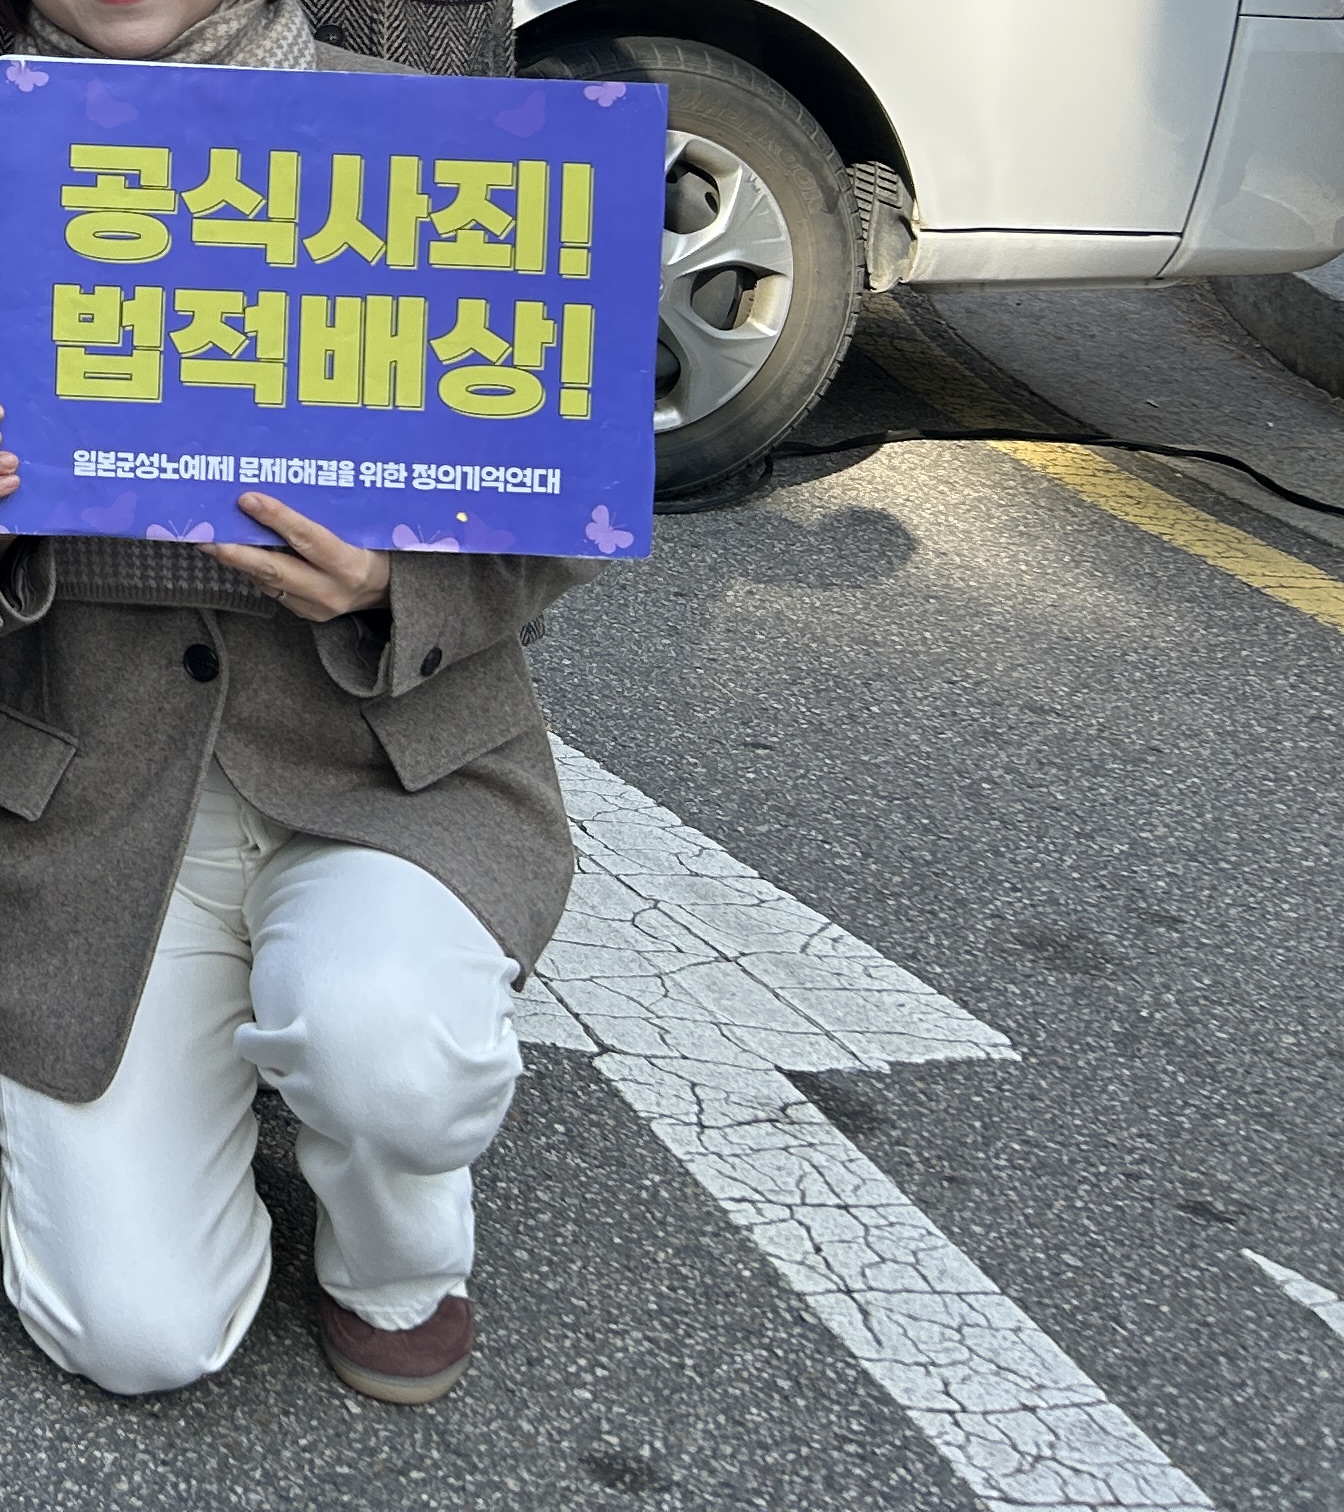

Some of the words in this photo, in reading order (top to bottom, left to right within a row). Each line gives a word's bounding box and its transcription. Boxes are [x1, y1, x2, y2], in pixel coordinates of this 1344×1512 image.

[60, 142, 594, 279] 공식사죄!
[50, 283, 595, 420] 법적배상!
[72, 448, 235, 485] 일본군성노예제
[239, 455, 356, 489] 문제해결을
[359, 460, 408, 491] 위한
[412, 462, 561, 496] 정의기억연대
